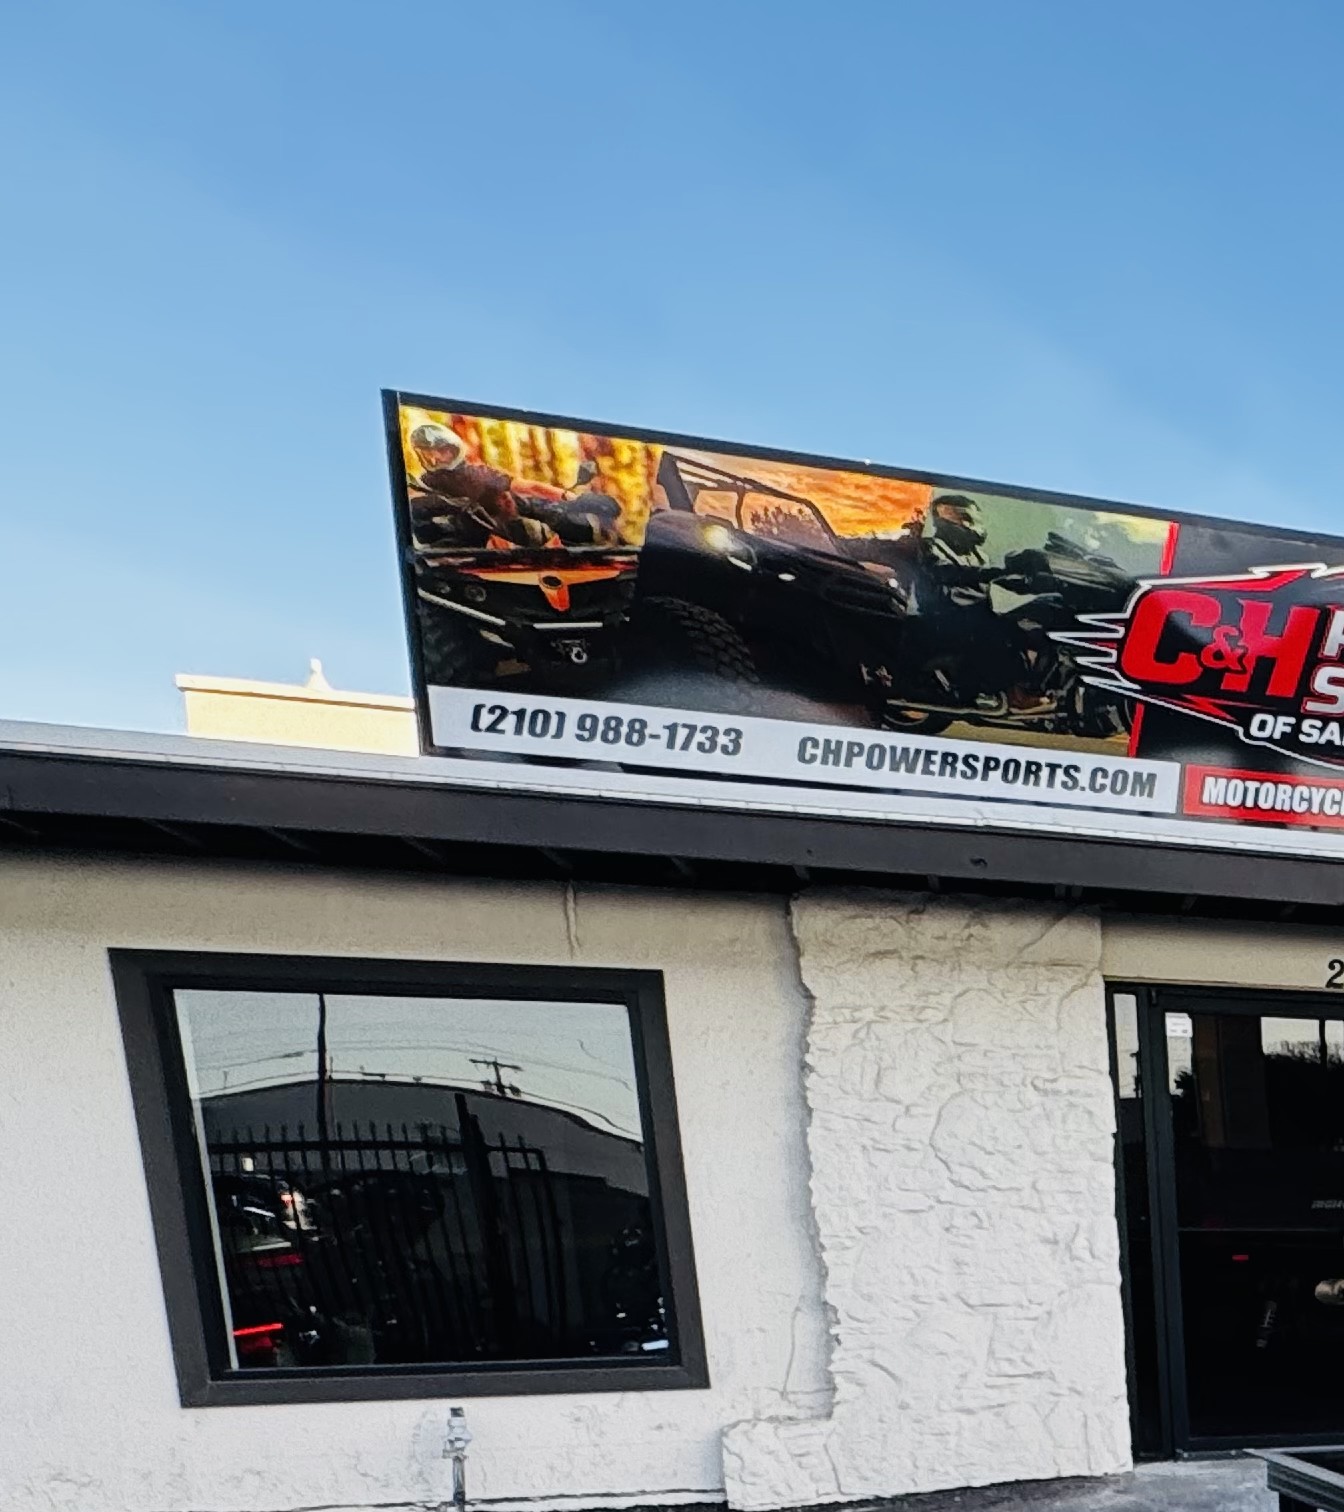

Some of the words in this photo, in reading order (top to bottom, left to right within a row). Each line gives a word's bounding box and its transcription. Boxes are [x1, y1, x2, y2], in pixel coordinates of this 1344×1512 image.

[1121, 589, 1320, 698] C&H
[470, 703, 567, 740] (210)
[575, 713, 744, 757] 988-1733
[1249, 712, 1297, 740] OF
[796, 735, 1158, 799] CHPOWERSPORTS.COM
